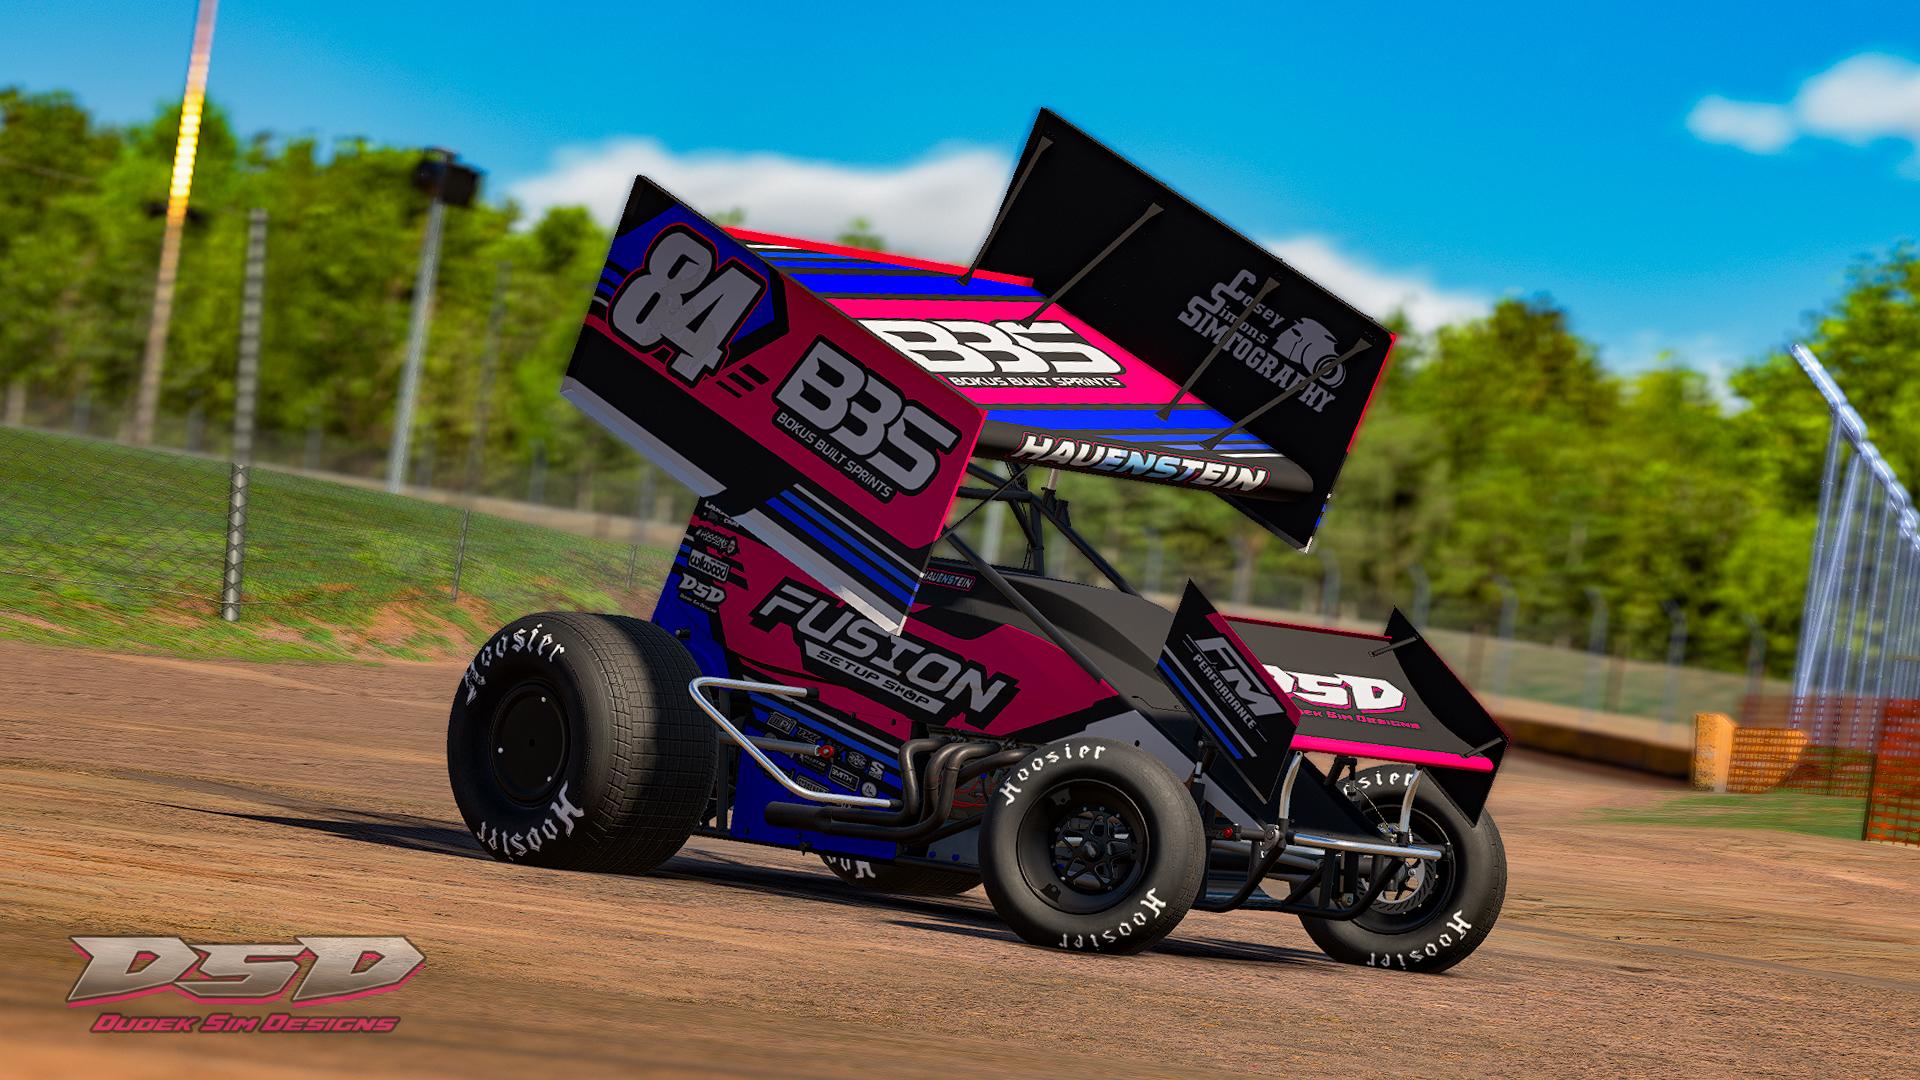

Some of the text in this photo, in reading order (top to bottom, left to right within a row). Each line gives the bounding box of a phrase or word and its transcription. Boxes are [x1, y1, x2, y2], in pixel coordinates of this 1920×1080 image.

[613, 232, 762, 382] 84
[949, 376, 1121, 387] BOKUS BUILT SPRINTS
[776, 412, 894, 498] BOKUS BUILT SPRINTS
[679, 572, 725, 603] DSD
[464, 623, 565, 705] Hoosier
[760, 583, 1007, 713] FUSION
[816, 649, 930, 705] SETUP SHOP
[1192, 653, 1257, 730] PERFORMANCE
[1000, 743, 1106, 806] Hoosier
[477, 780, 585, 860] Hoosier
[1058, 888, 1167, 950] Hoosier
[1366, 910, 1472, 970] Hoosier
